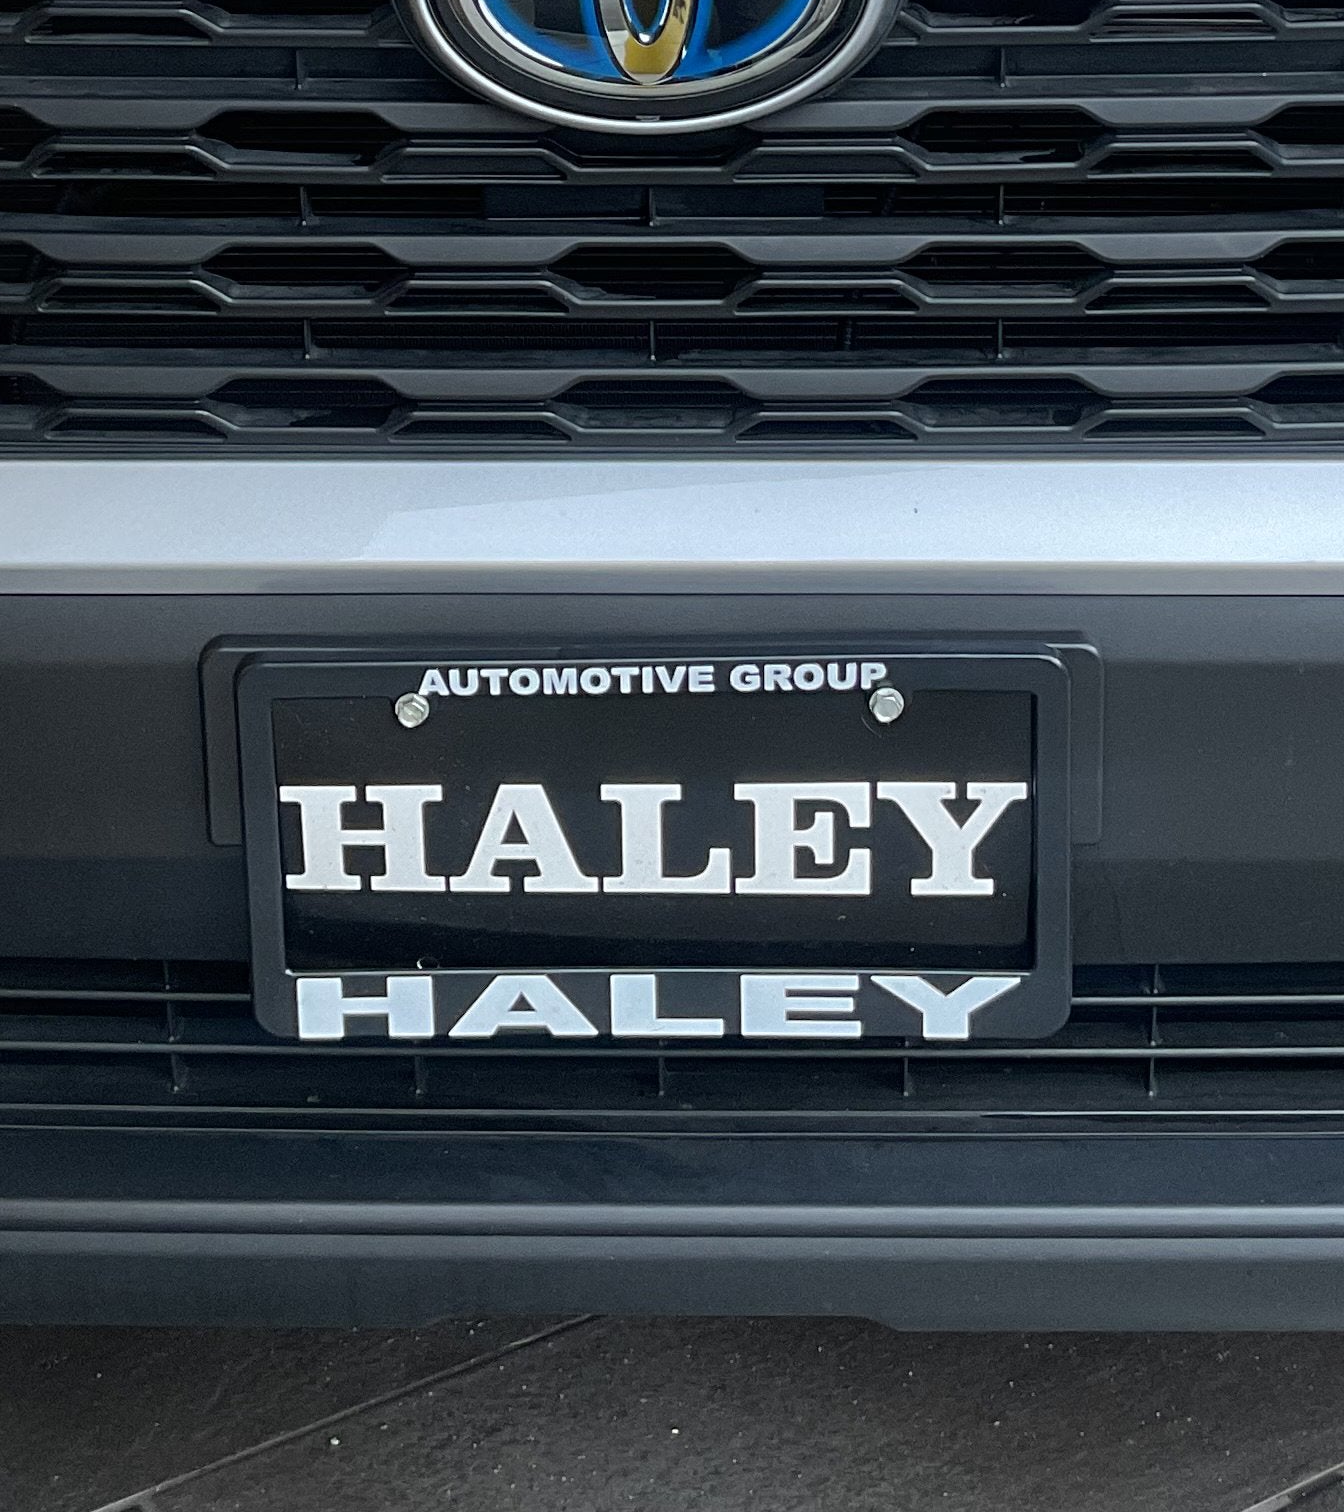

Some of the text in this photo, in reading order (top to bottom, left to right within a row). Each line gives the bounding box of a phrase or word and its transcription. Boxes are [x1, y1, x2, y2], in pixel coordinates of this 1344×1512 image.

[418, 661, 888, 698] AUTOMOTIVE GROUP
[279, 781, 1028, 896] HALEY
[295, 974, 1023, 1041] HALEY
